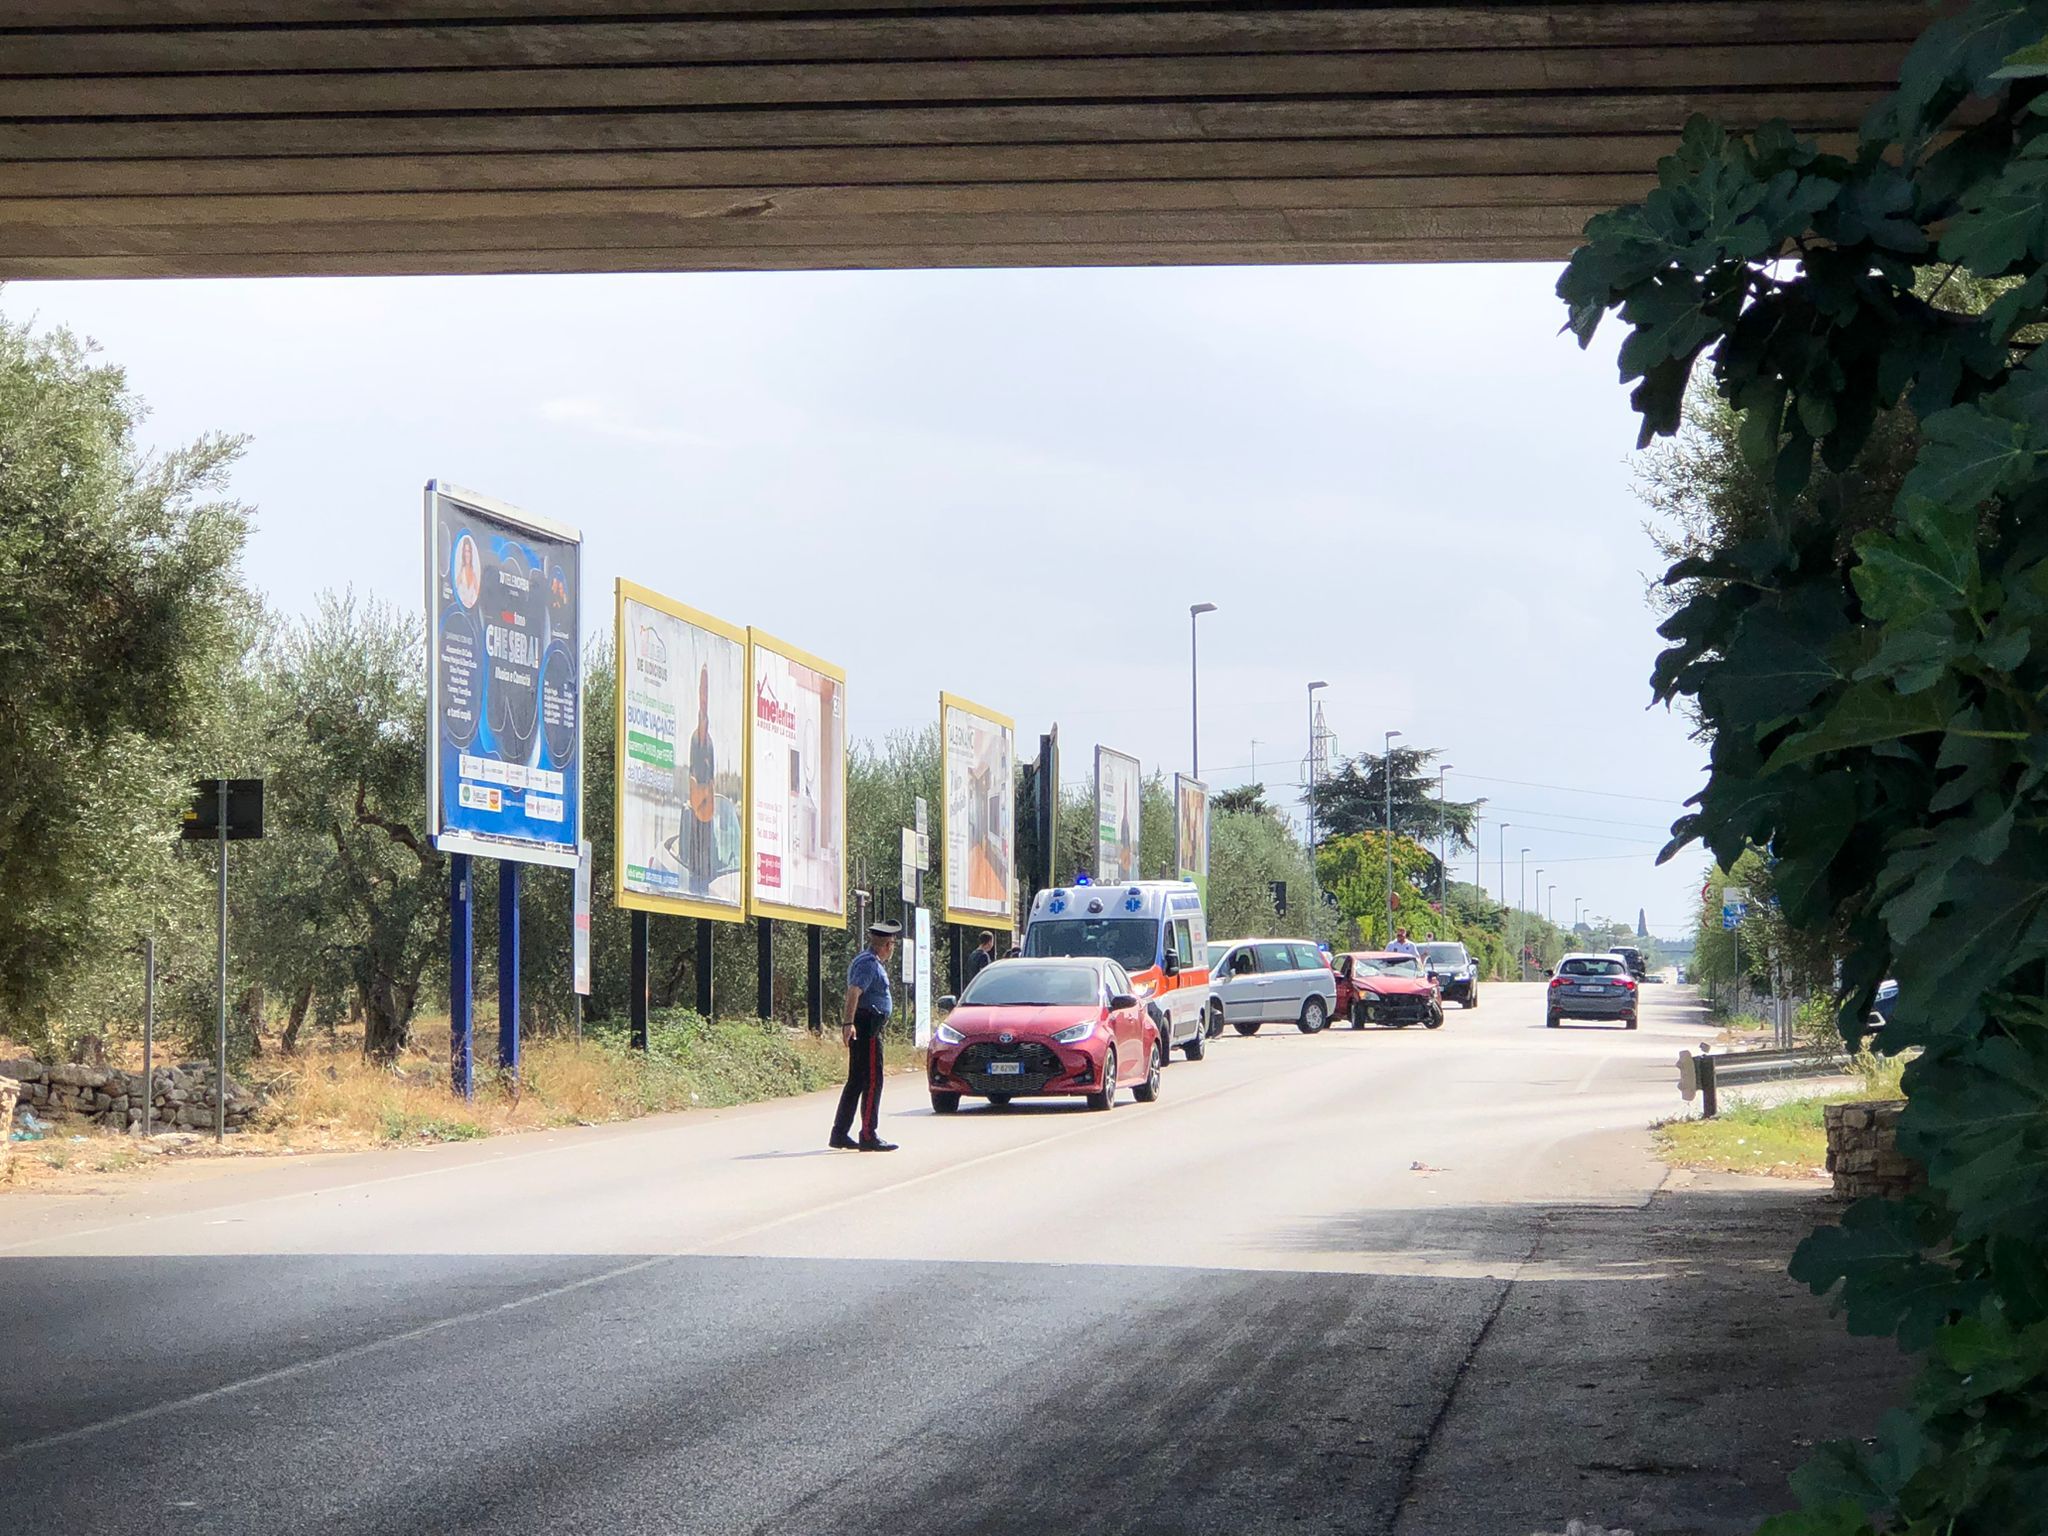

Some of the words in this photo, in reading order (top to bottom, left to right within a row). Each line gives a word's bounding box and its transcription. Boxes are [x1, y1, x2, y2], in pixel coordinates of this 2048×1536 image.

[486, 624, 508, 660] CHE
[508, 630, 539, 669] SERA!
[628, 705, 648, 728] BUONE
[648, 711, 674, 736] VACANZE
